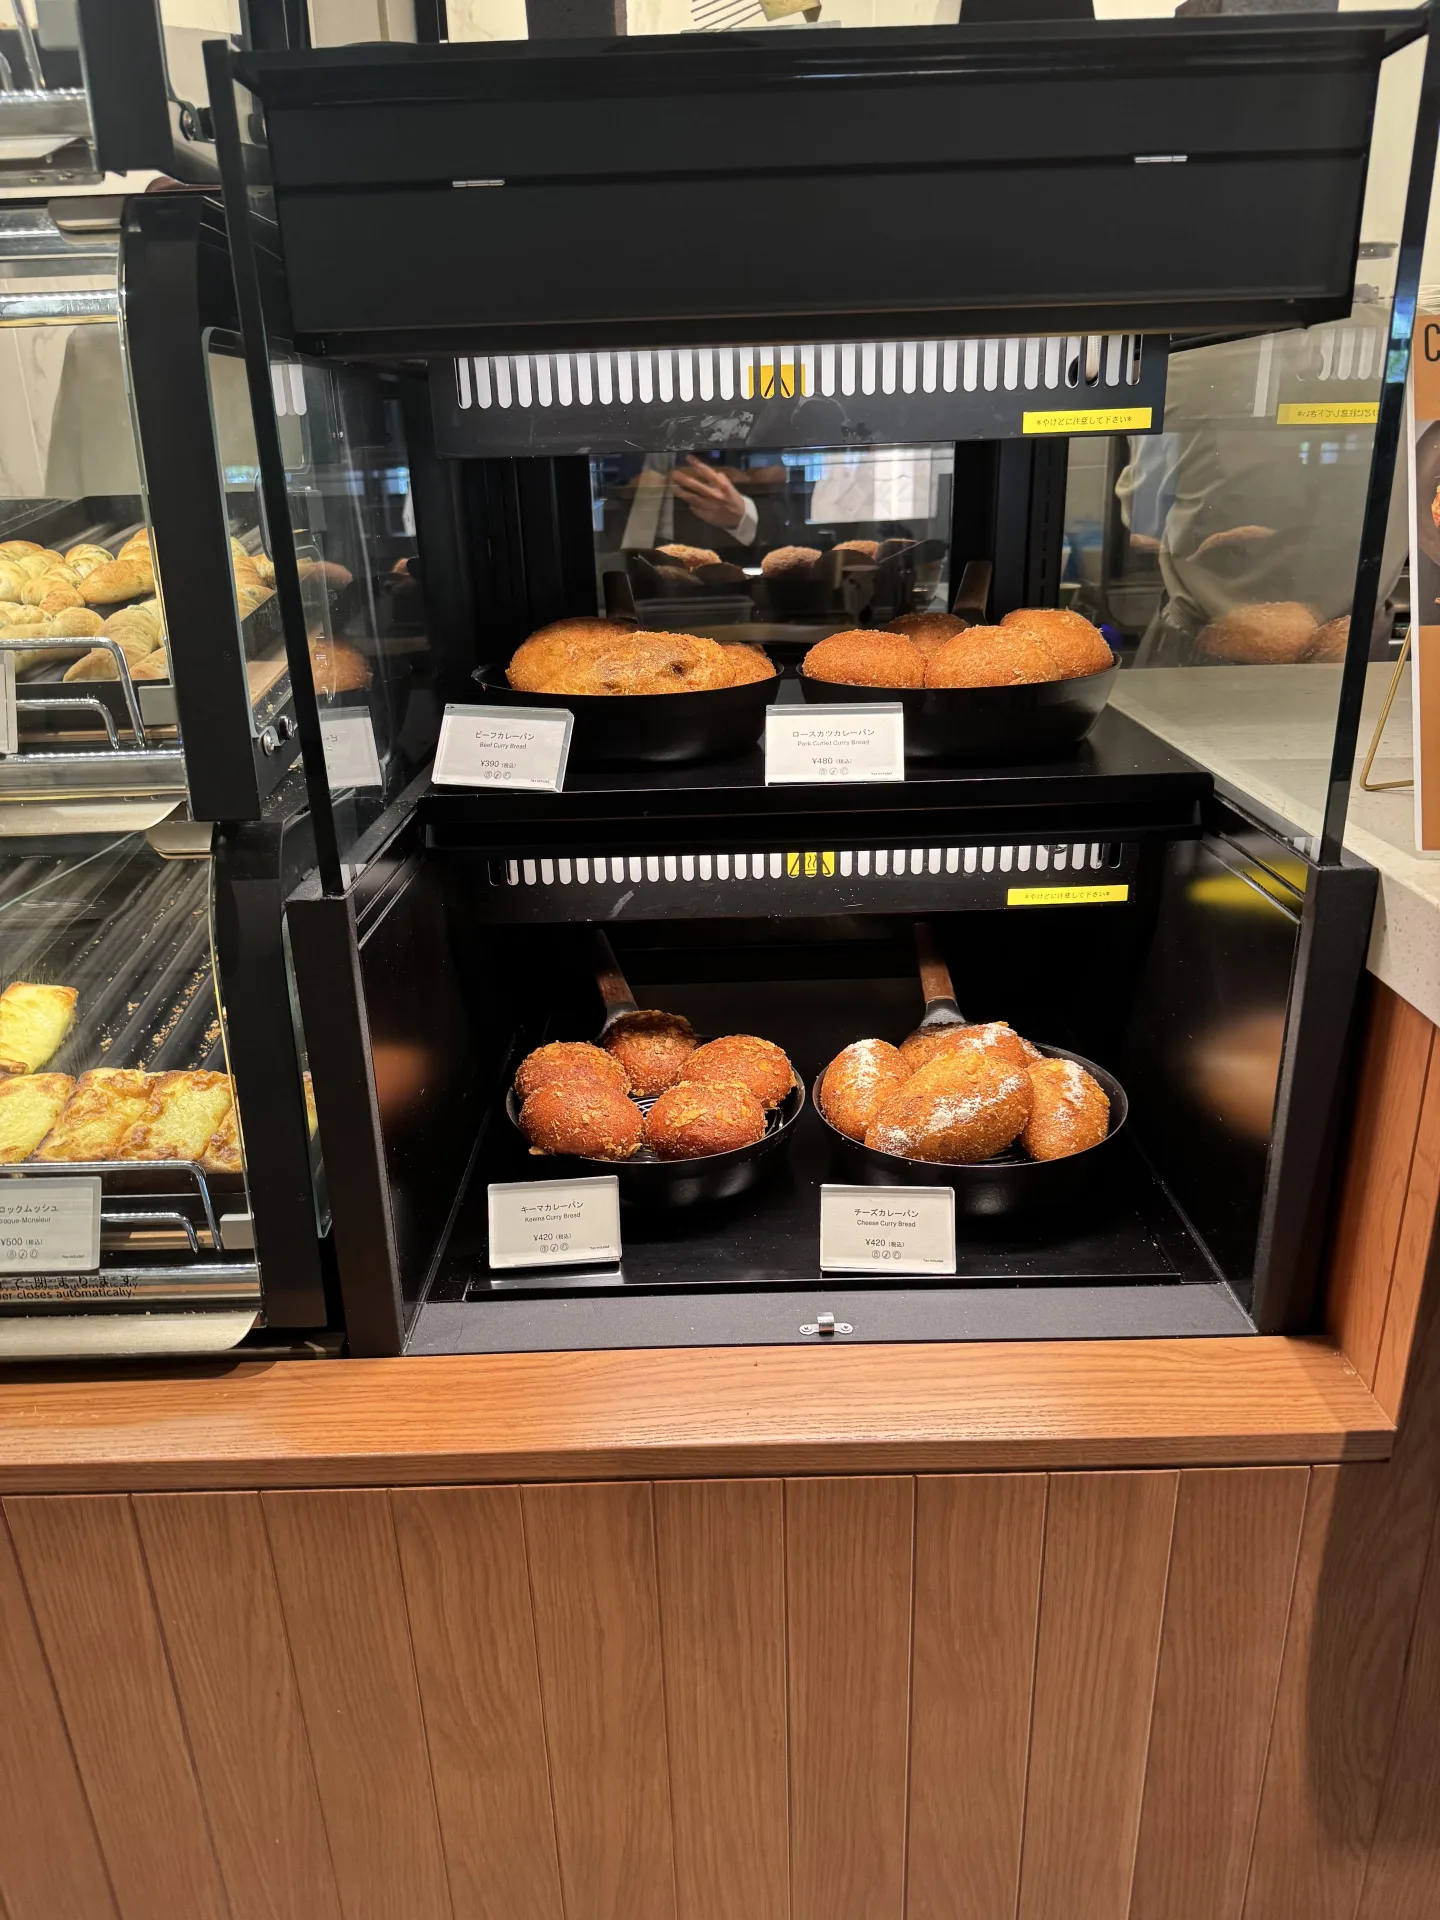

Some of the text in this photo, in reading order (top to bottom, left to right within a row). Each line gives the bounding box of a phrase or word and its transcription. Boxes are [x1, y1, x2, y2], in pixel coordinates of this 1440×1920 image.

[475, 730, 535, 741] ビーフカレーパン
[792, 728, 875, 738] ロースカツカレーパン
[493, 742, 509, 750] Curry
[480, 760, 499, 768] ¥390
[812, 757, 833, 765] ¥480
[521, 1199, 584, 1214] キーマカレーパン
[524, 1211, 581, 1223] Keema Curry Bread
[854, 1208, 919, 1218] チーズカレーパン
[880, 1220, 897, 1228] Curry
[0, 1237, 23, 1246] ¥500
[533, 1233, 553, 1241] ¥420
[865, 1239, 886, 1247] ¥420
[17, 1290, 53, 1300] closes
